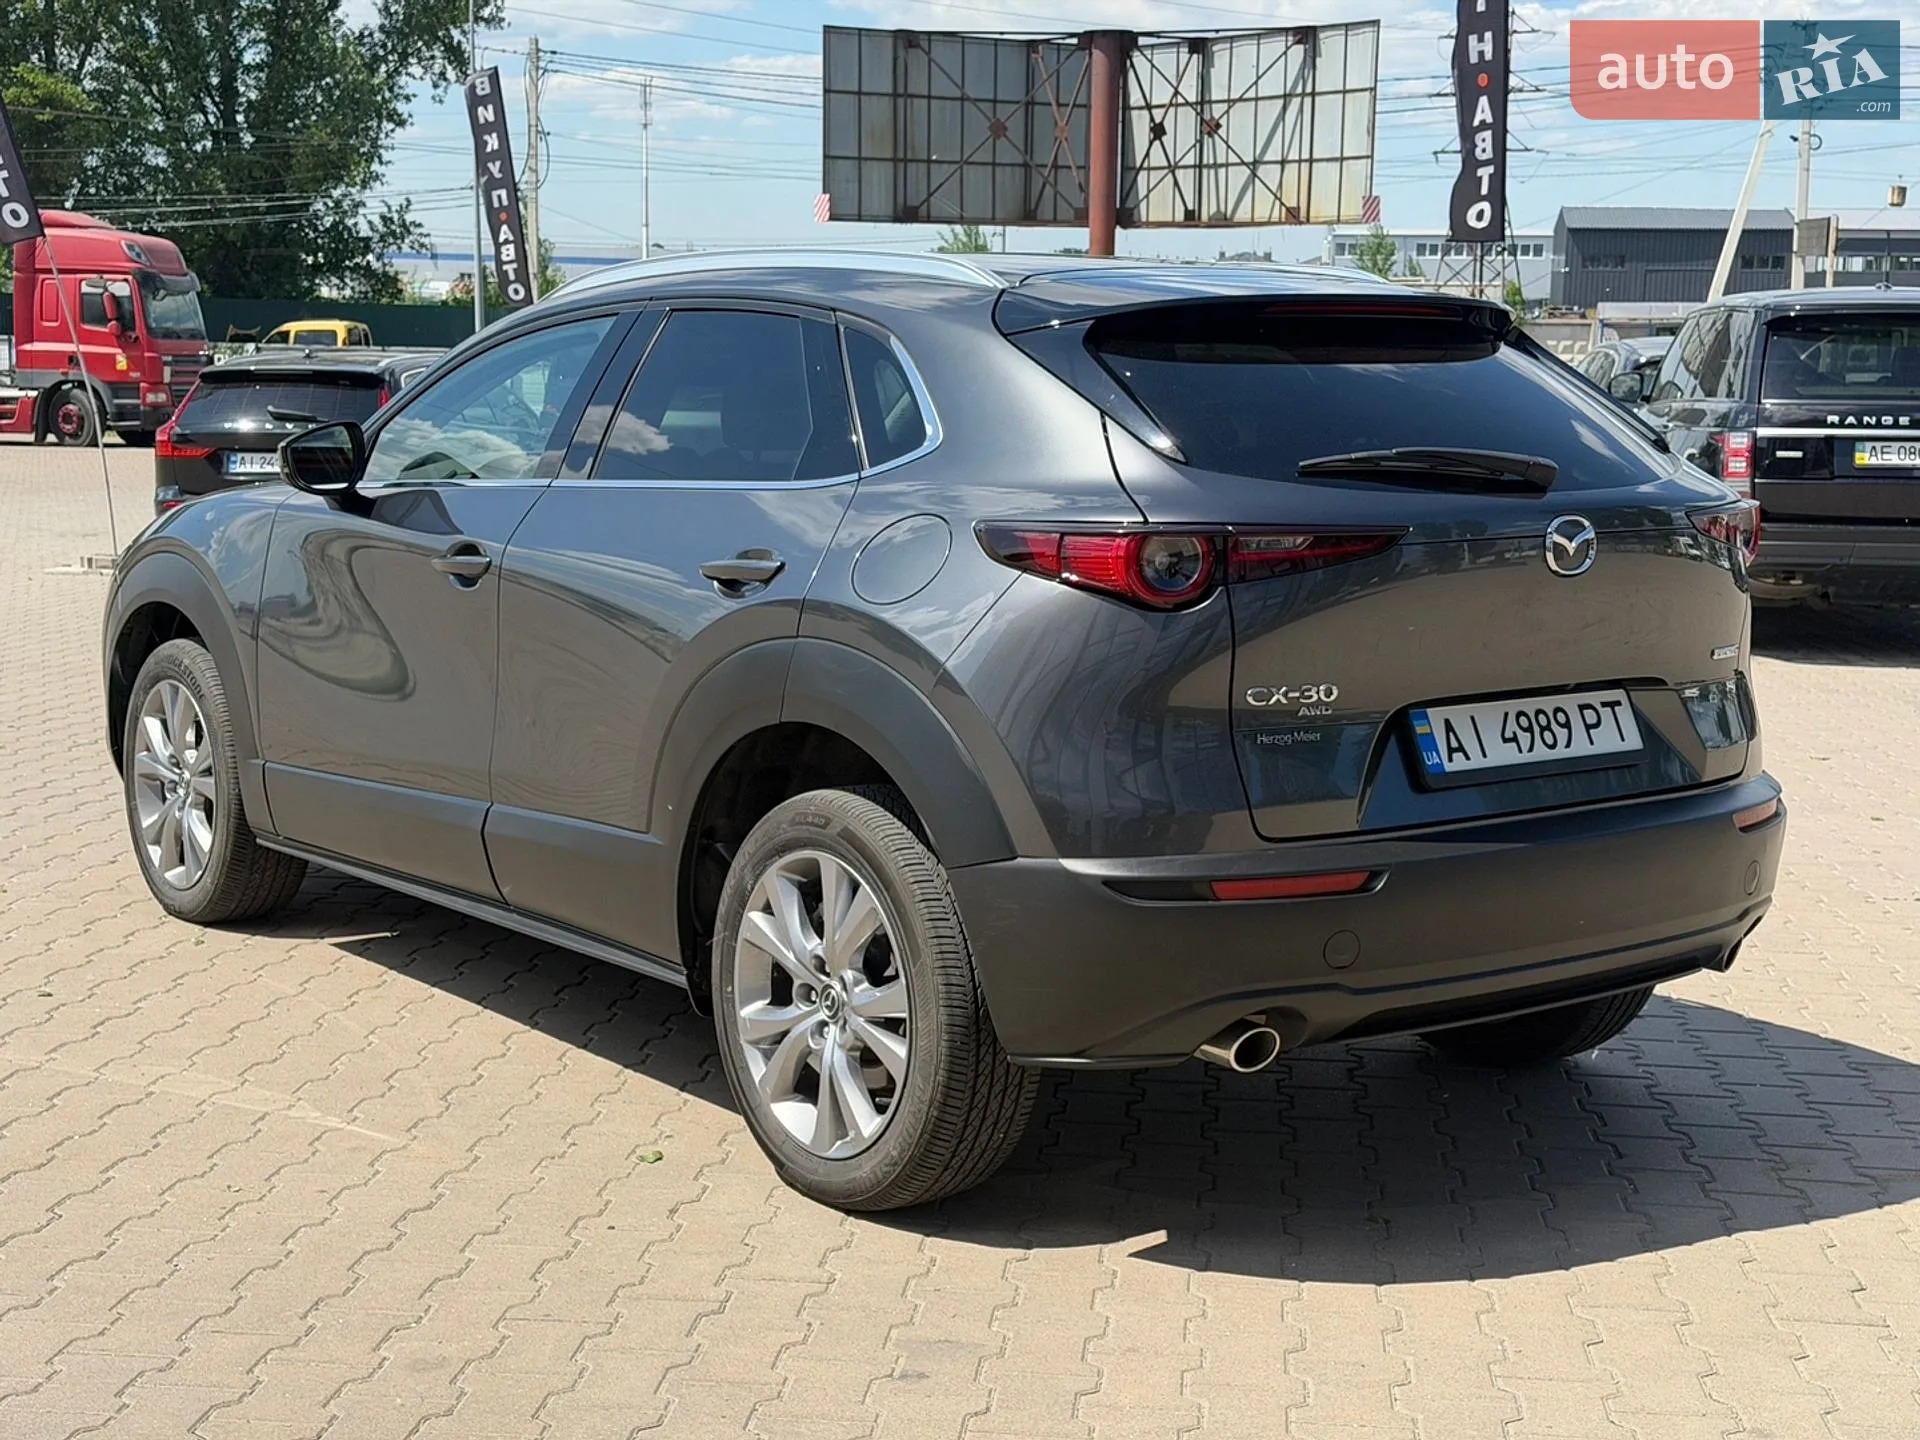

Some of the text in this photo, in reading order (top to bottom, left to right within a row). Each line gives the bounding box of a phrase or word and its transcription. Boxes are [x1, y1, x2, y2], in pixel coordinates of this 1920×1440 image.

[1826, 414, 1911, 426] RANGE
[239, 455, 279, 469] AI 24
[1867, 445, 1920, 462] AE 08
[1245, 683, 1339, 706] CX-30
[1297, 705, 1333, 717] AWD
[1255, 730, 1321, 747] Herzog-Meier
[1443, 699, 1627, 764] AI 4989 PT
[1423, 749, 1442, 766] UA
